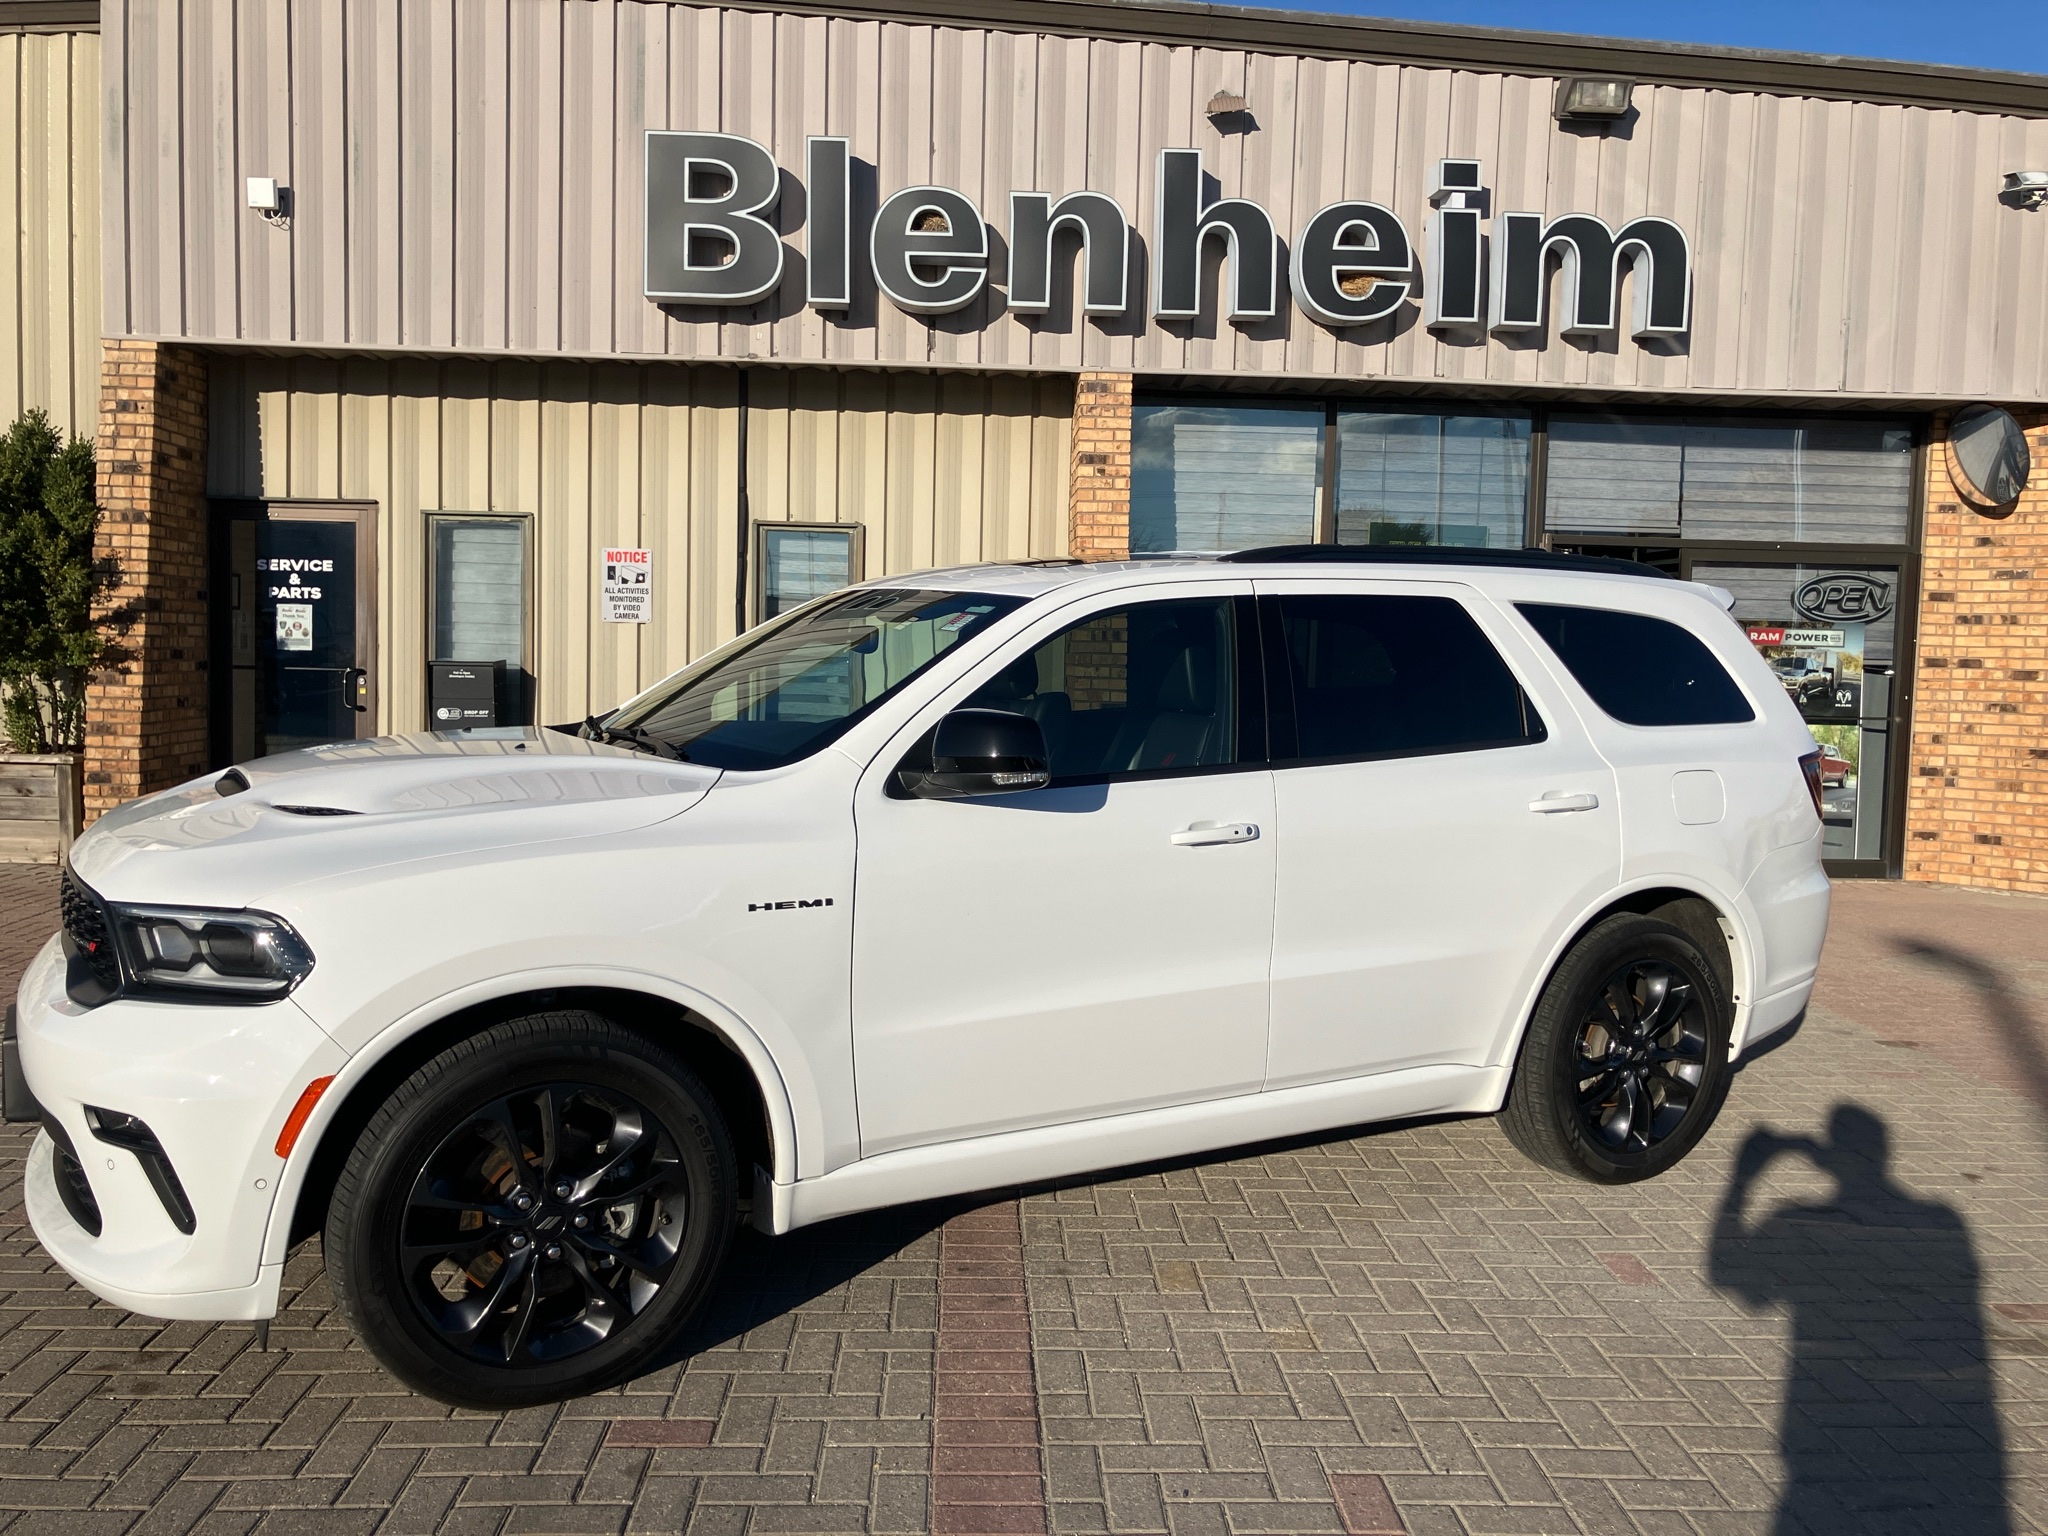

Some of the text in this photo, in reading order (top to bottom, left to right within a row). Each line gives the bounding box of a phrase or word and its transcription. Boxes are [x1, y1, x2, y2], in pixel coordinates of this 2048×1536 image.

[643, 130, 1692, 338] Blenheim
[607, 551, 647, 563] NOTICE
[257, 559, 333, 572] SERVICE
[289, 573, 301, 585] &
[268, 586, 322, 599] PARTS
[617, 587, 650, 595] ACTIVITIES
[609, 595, 645, 603] MONITORED
[1800, 585, 1890, 610] OPEN
[622, 604, 641, 612] VIDEO
[614, 612, 640, 620] CAMERA
[1750, 632, 1780, 641] RAM
[1785, 633, 1829, 642] POWER
[748, 897, 834, 912] HEMI
